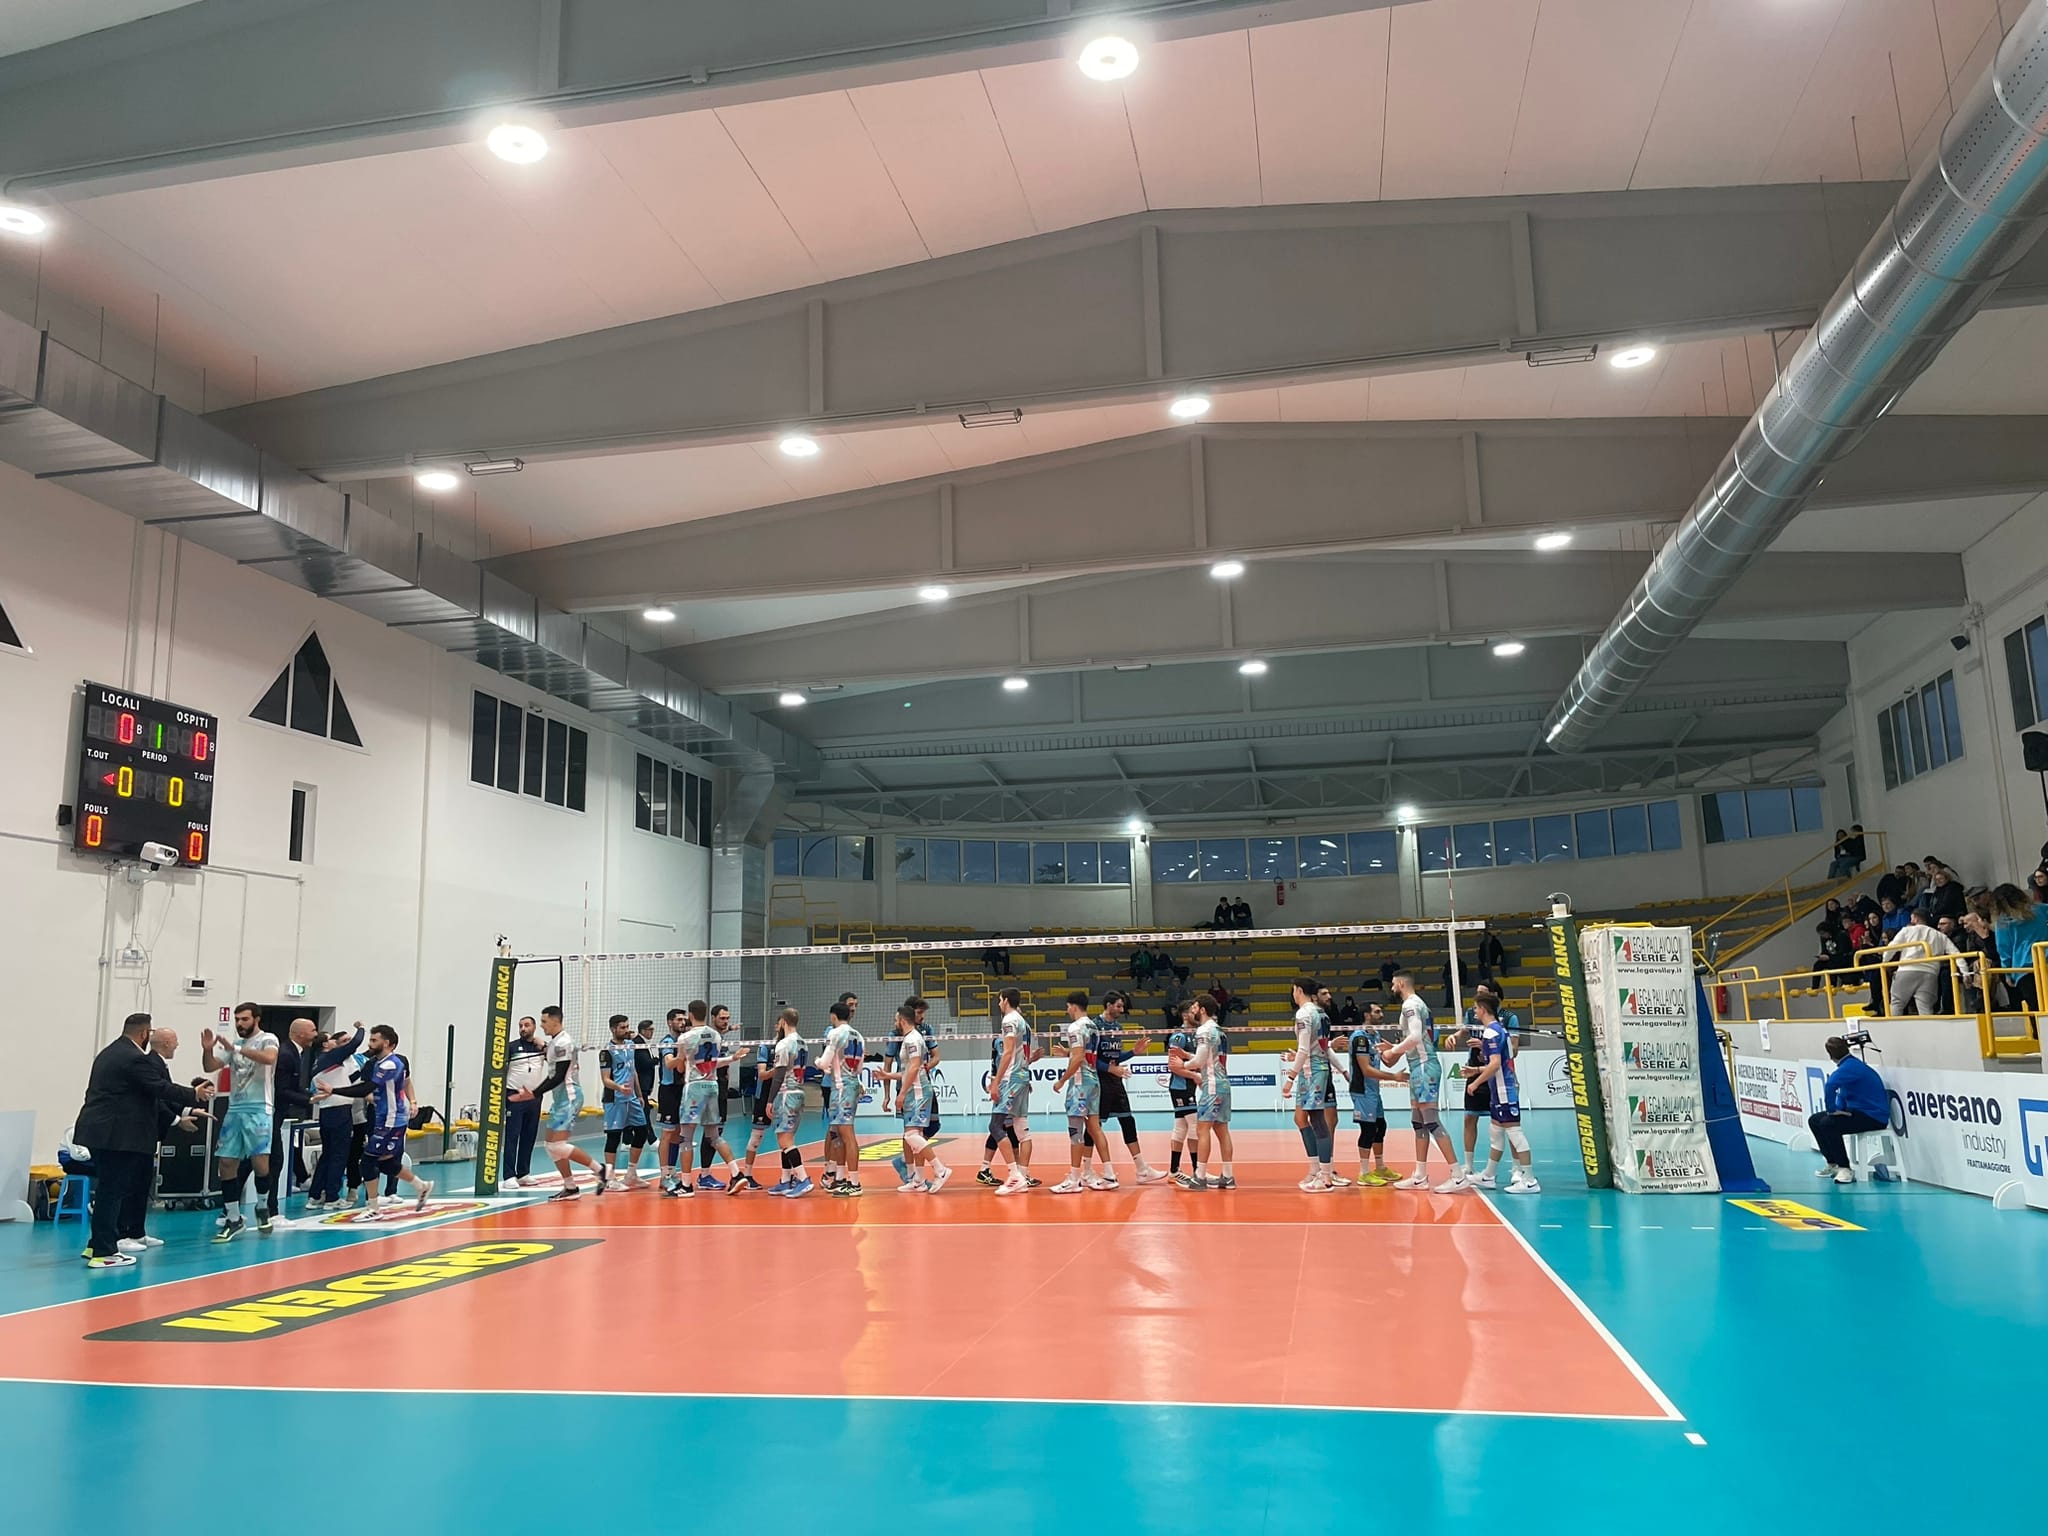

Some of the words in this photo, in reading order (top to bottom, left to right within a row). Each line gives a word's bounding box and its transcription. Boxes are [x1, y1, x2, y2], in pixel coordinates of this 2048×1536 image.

[101, 691, 140, 711] LOCALI
[119, 713, 134, 744] 0
[176, 711, 209, 729] OSPITI
[87, 748, 109, 761] T.OUT
[193, 732, 209, 761] 0
[142, 750, 168, 763] PERIOD
[118, 766, 134, 798] 0
[194, 772, 213, 783] T.OUT
[168, 776, 184, 807] 0
[84, 803, 109, 815] FOULS
[86, 815, 103, 847] 0
[187, 821, 209, 832] FOULS
[188, 831, 203, 861] 0
[1552, 924, 1572, 978] BANCA
[1633, 954, 1667, 962] SERIE
[1670, 954, 1679, 962] A
[1617, 967, 1682, 975] www.legavolley.it
[496, 964, 511, 1012] BANCA
[1559, 984, 1580, 1045] CREDEM
[1638, 1006, 1672, 1015] SERIE
[1676, 1006, 1685, 1015] A
[1622, 1020, 1687, 1028] www.legavolley.it
[491, 1016, 508, 1070] CREDEM
[1132, 1065, 1169, 1073] PERFE
[1642, 1060, 1676, 1069] SERIE
[1680, 1060, 1688, 1069] A
[1547, 1082, 1571, 1094] Smok
[1566, 1052, 1590, 1108] BANCA
[488, 1076, 503, 1124] BANCA
[1906, 1090, 2002, 1126] aversano
[1647, 1114, 1679, 1123] SERIE
[1684, 1113, 1693, 1122] A
[1632, 1127, 1694, 1136] www.legavolley.it
[1577, 1113, 1599, 1176] CREDEM
[1961, 1129, 2007, 1159] industry
[483, 1130, 499, 1186] CREDEM
[1966, 1158, 2012, 1174] FRATTAMAGGIORE
[1655, 1168, 1690, 1178] SERIE
[1694, 1167, 1704, 1175] A
[1641, 1180, 1708, 1190] www.legavolley.it
[161, 1242, 555, 1334] CREDEM
